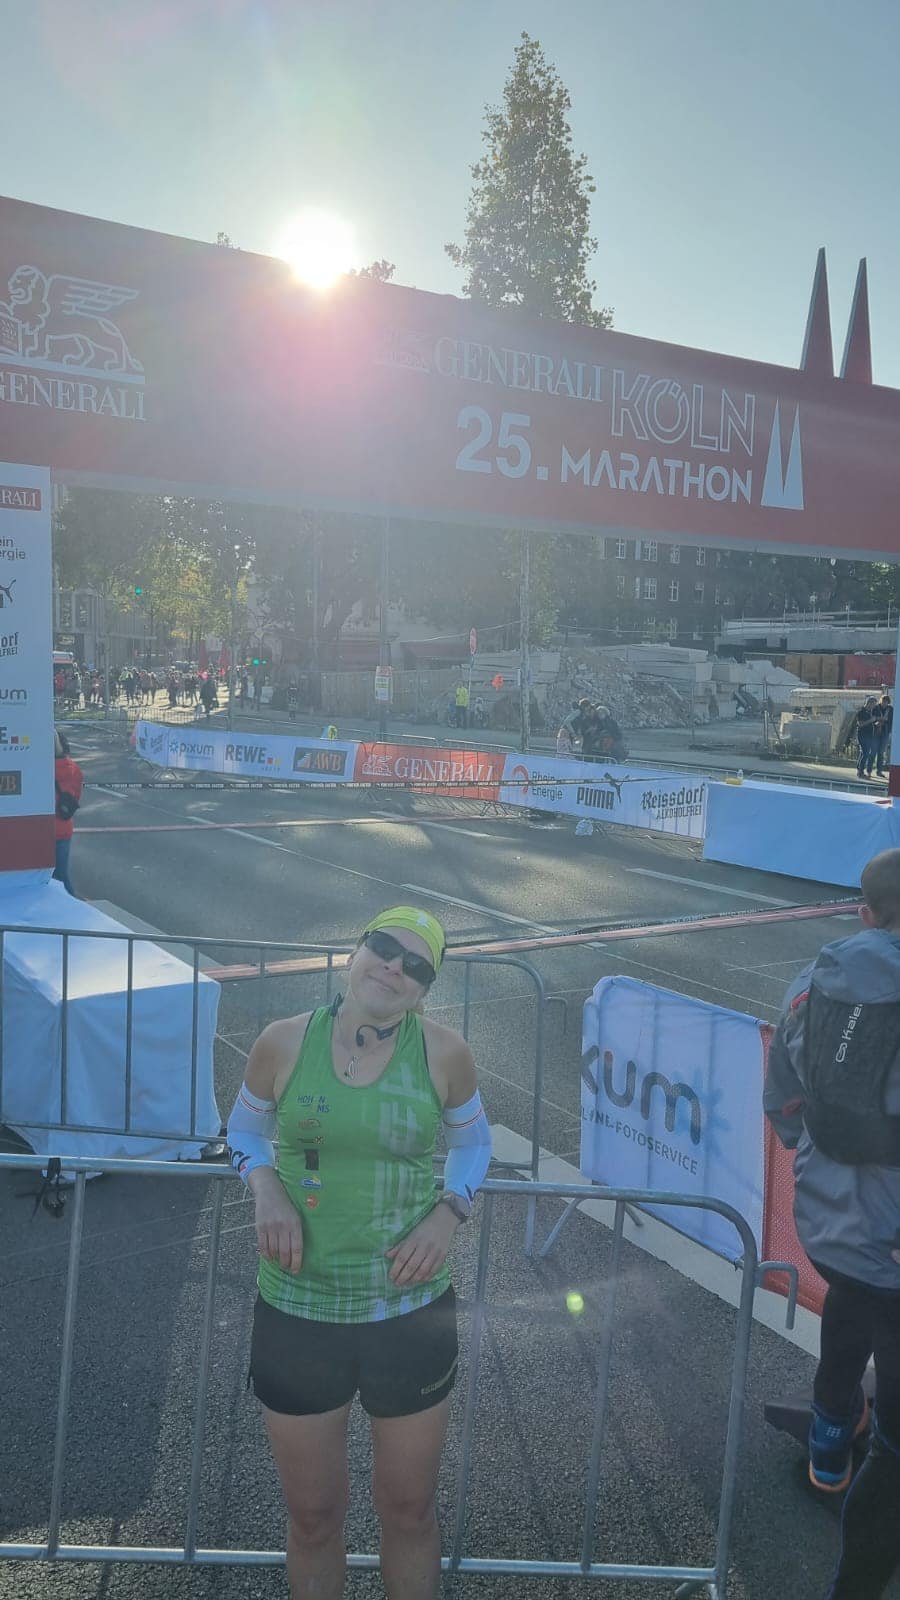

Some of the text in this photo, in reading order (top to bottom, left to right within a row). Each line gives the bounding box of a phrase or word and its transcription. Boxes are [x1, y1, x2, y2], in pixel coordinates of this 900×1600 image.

[434, 337, 756, 457] GENERALI KÖLN
[456, 404, 753, 505] 25. MARATHON
[180, 743, 215, 757] pixum
[225, 744, 267, 764] REWE
[314, 752, 341, 772] AWB
[394, 757, 496, 782] GENERALI
[576, 787, 615, 810] PUMA
[641, 783, 705, 811] Reissdorf
